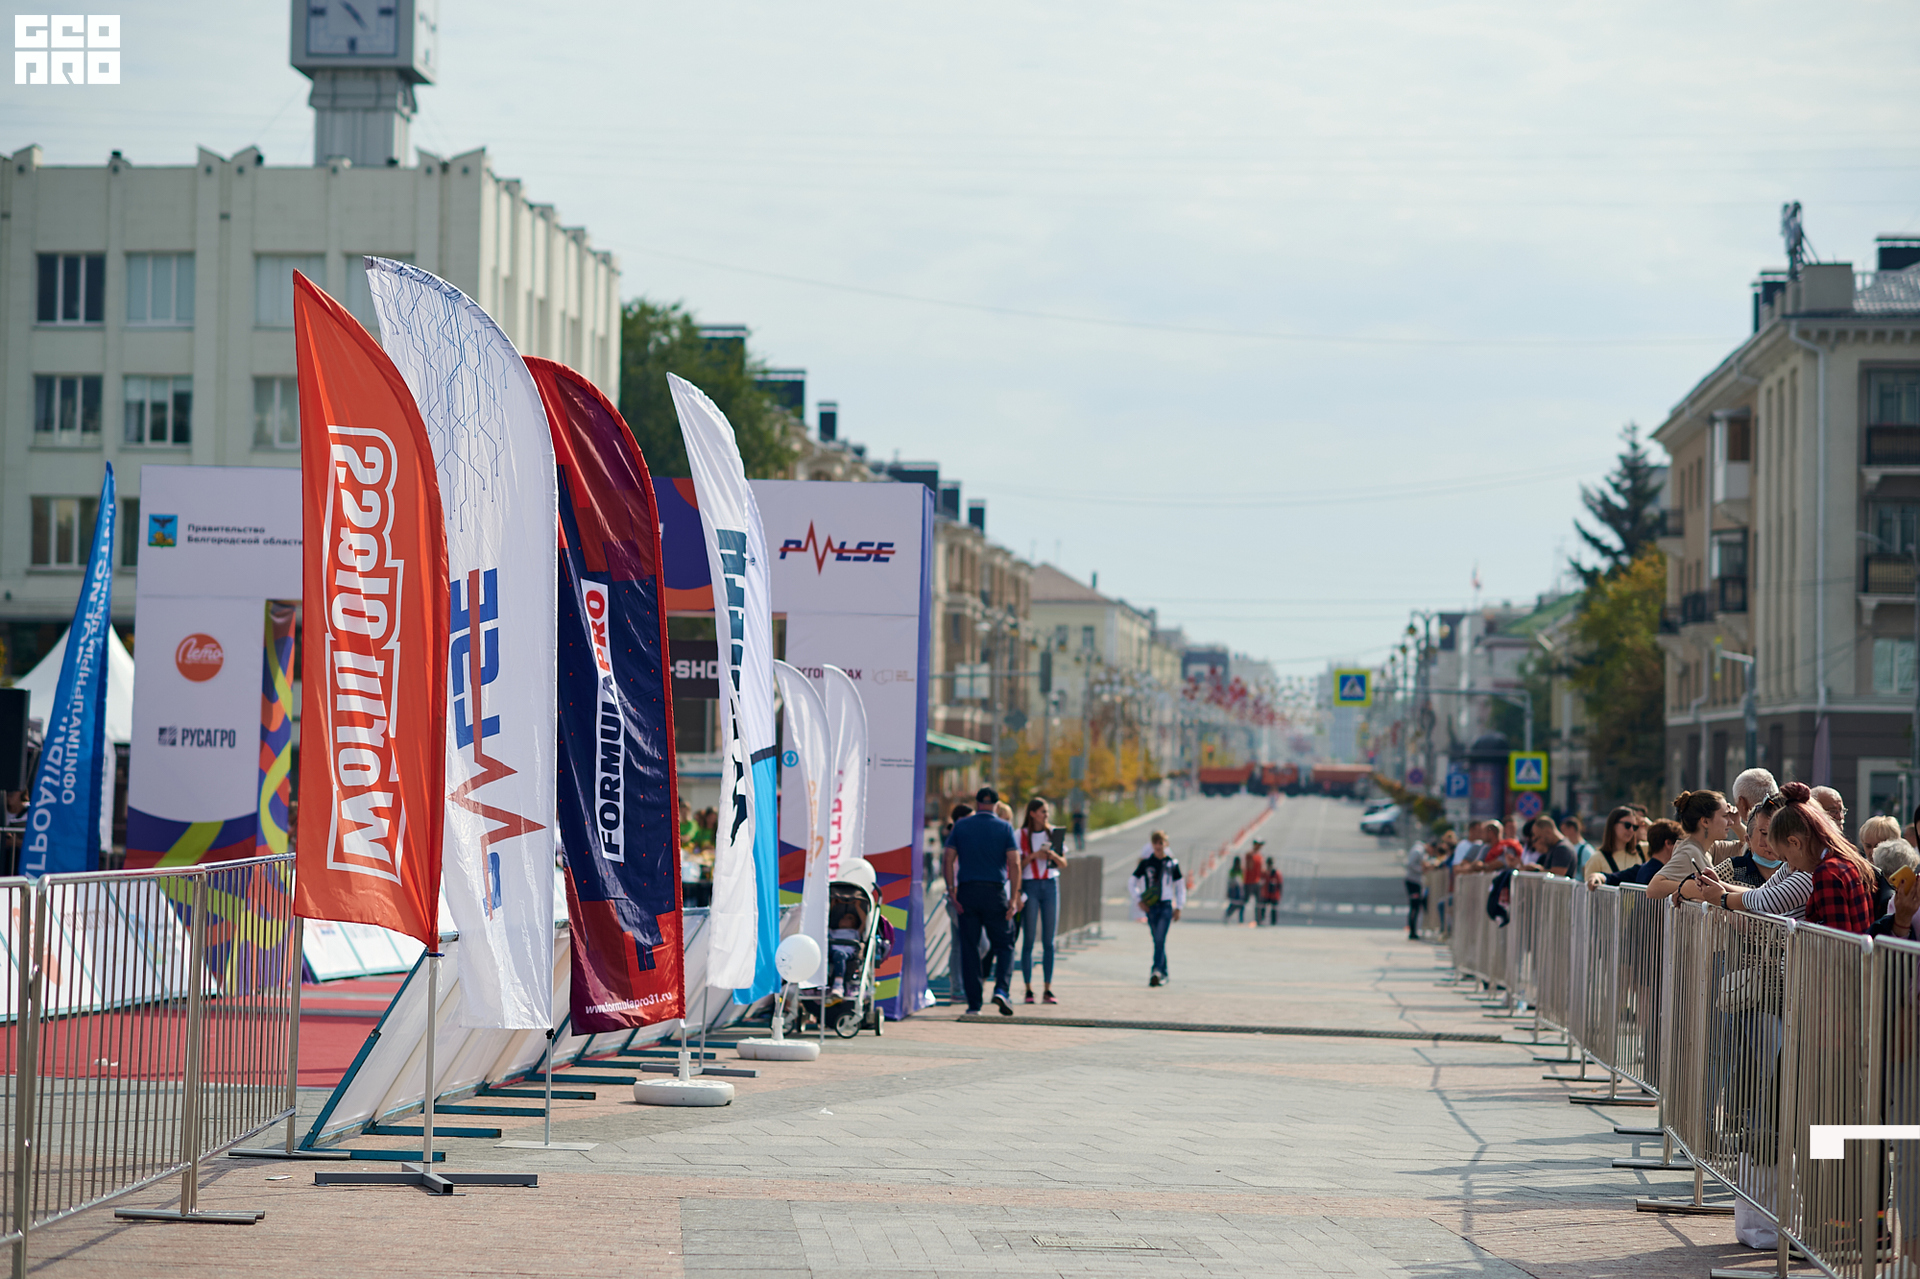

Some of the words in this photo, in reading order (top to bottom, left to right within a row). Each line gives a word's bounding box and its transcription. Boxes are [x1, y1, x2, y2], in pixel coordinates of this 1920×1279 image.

[187, 523, 266, 534] Правительство
[187, 535, 260, 546] Белгородской
[181, 727, 236, 749] РУСАГРО
